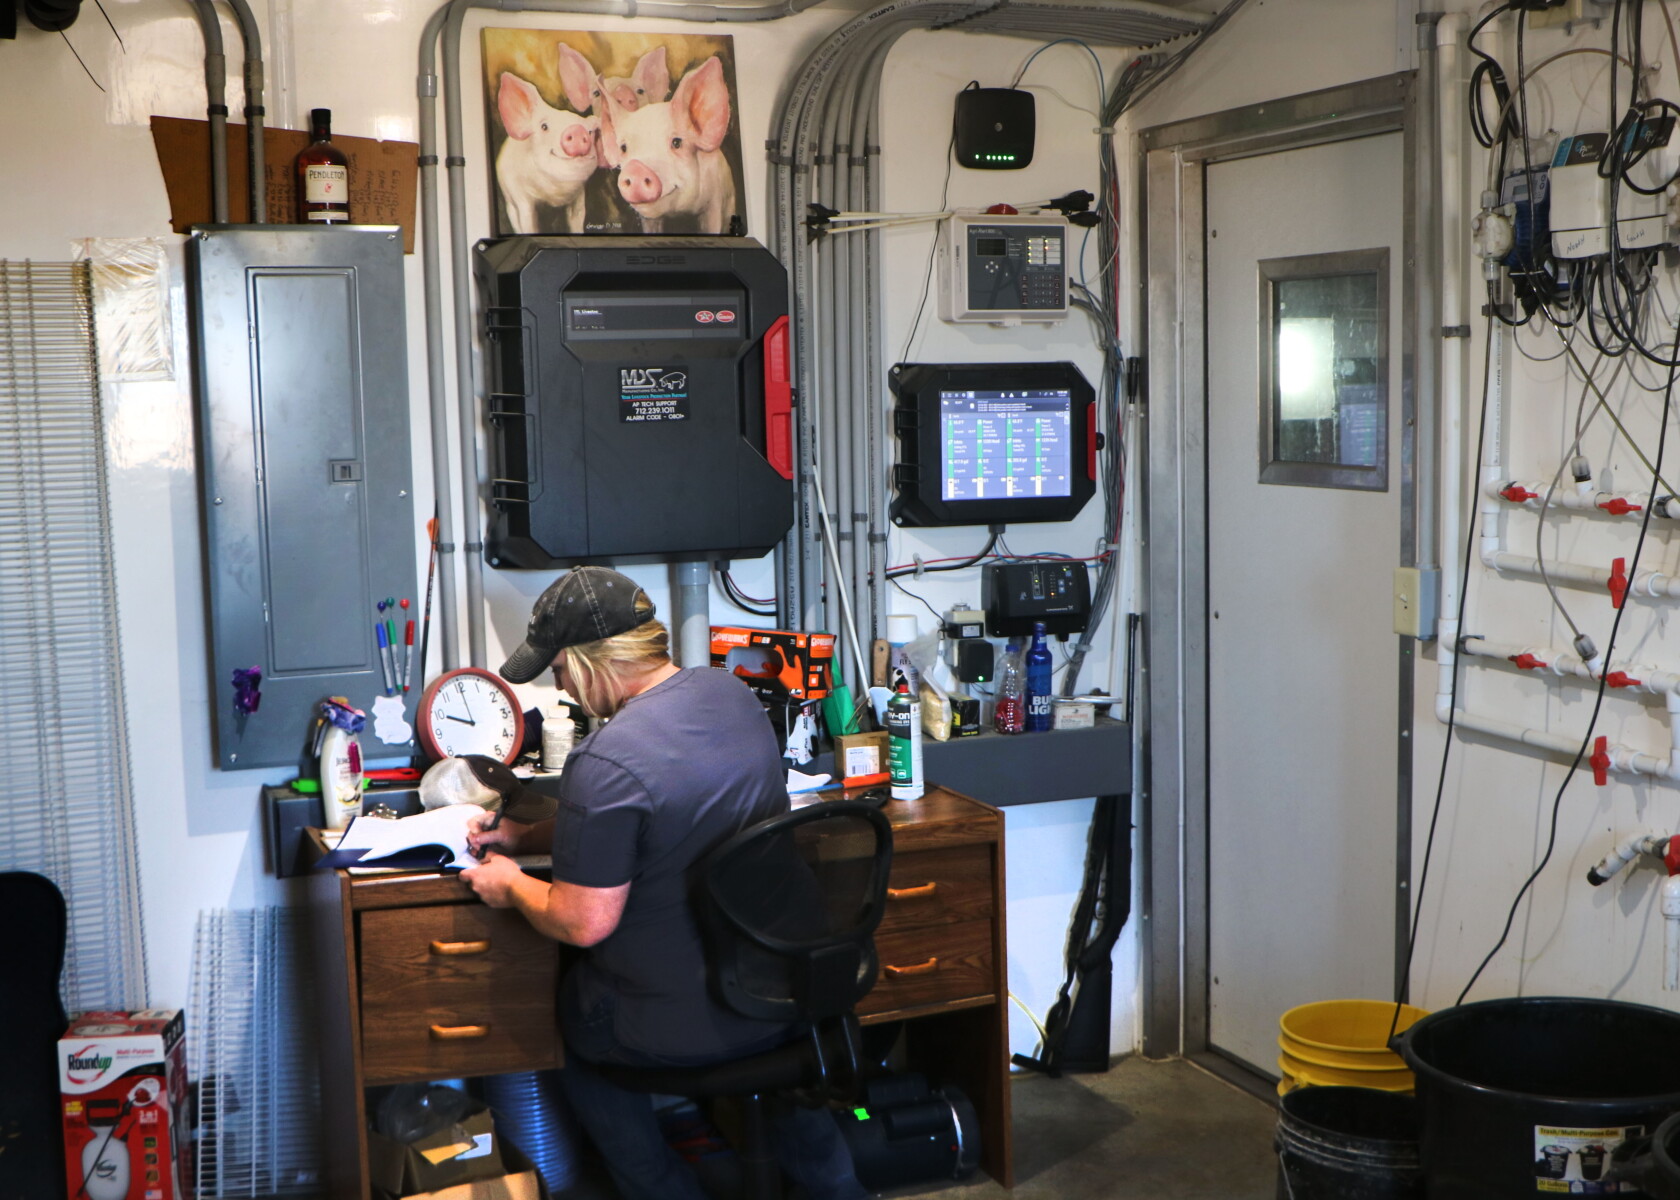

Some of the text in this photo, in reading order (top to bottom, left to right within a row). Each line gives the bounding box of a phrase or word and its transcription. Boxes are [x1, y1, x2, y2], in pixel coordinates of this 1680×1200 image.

[308, 170, 344, 179] PENDLETON
[626, 256, 686, 265] EDGE
[621, 368, 663, 389] MDS
[454, 682, 465, 693] 12
[475, 682, 480, 693] 1
[442, 693, 450, 703] 11
[489, 692, 497, 703] 2
[1032, 696, 1050, 705] BU
[434, 709, 445, 720] 10
[500, 708, 508, 719] 3
[436, 728, 442, 740] 9
[502, 729, 509, 739] 4
[447, 746, 454, 757] 8
[494, 745, 502, 756] 5
[68, 1053, 112, 1073] Roundup
